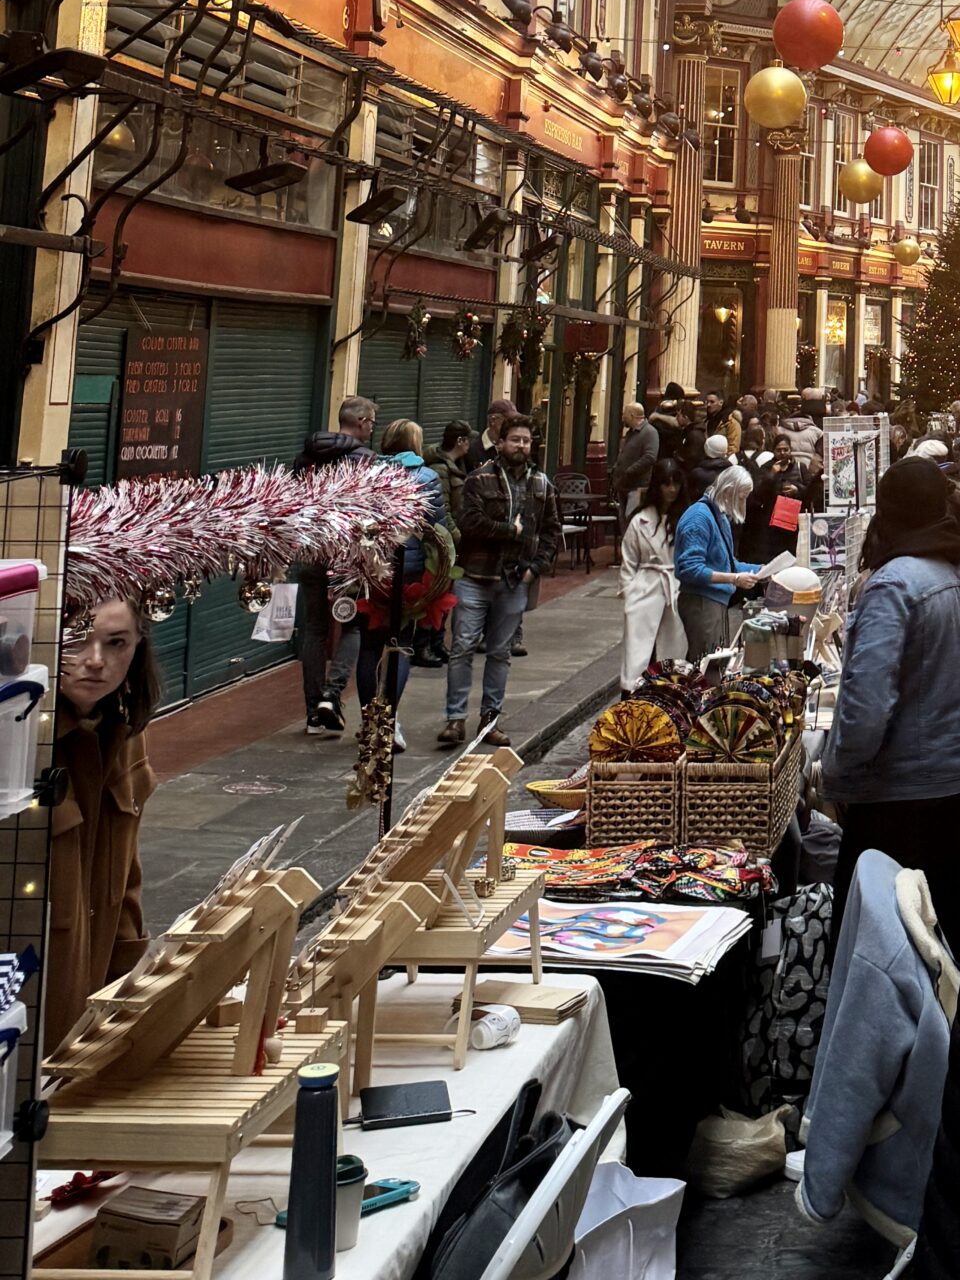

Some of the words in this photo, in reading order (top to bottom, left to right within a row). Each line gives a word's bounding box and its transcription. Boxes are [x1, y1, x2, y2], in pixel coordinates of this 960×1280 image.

[341, 5, 350, 30] 6
[544, 118, 572, 147] ESPRESSO
[571, 131, 583, 152] BAR
[703, 239, 745, 251] TAVERN
[798, 256, 813, 266] LAMB
[832, 261, 851, 271] TAVERN
